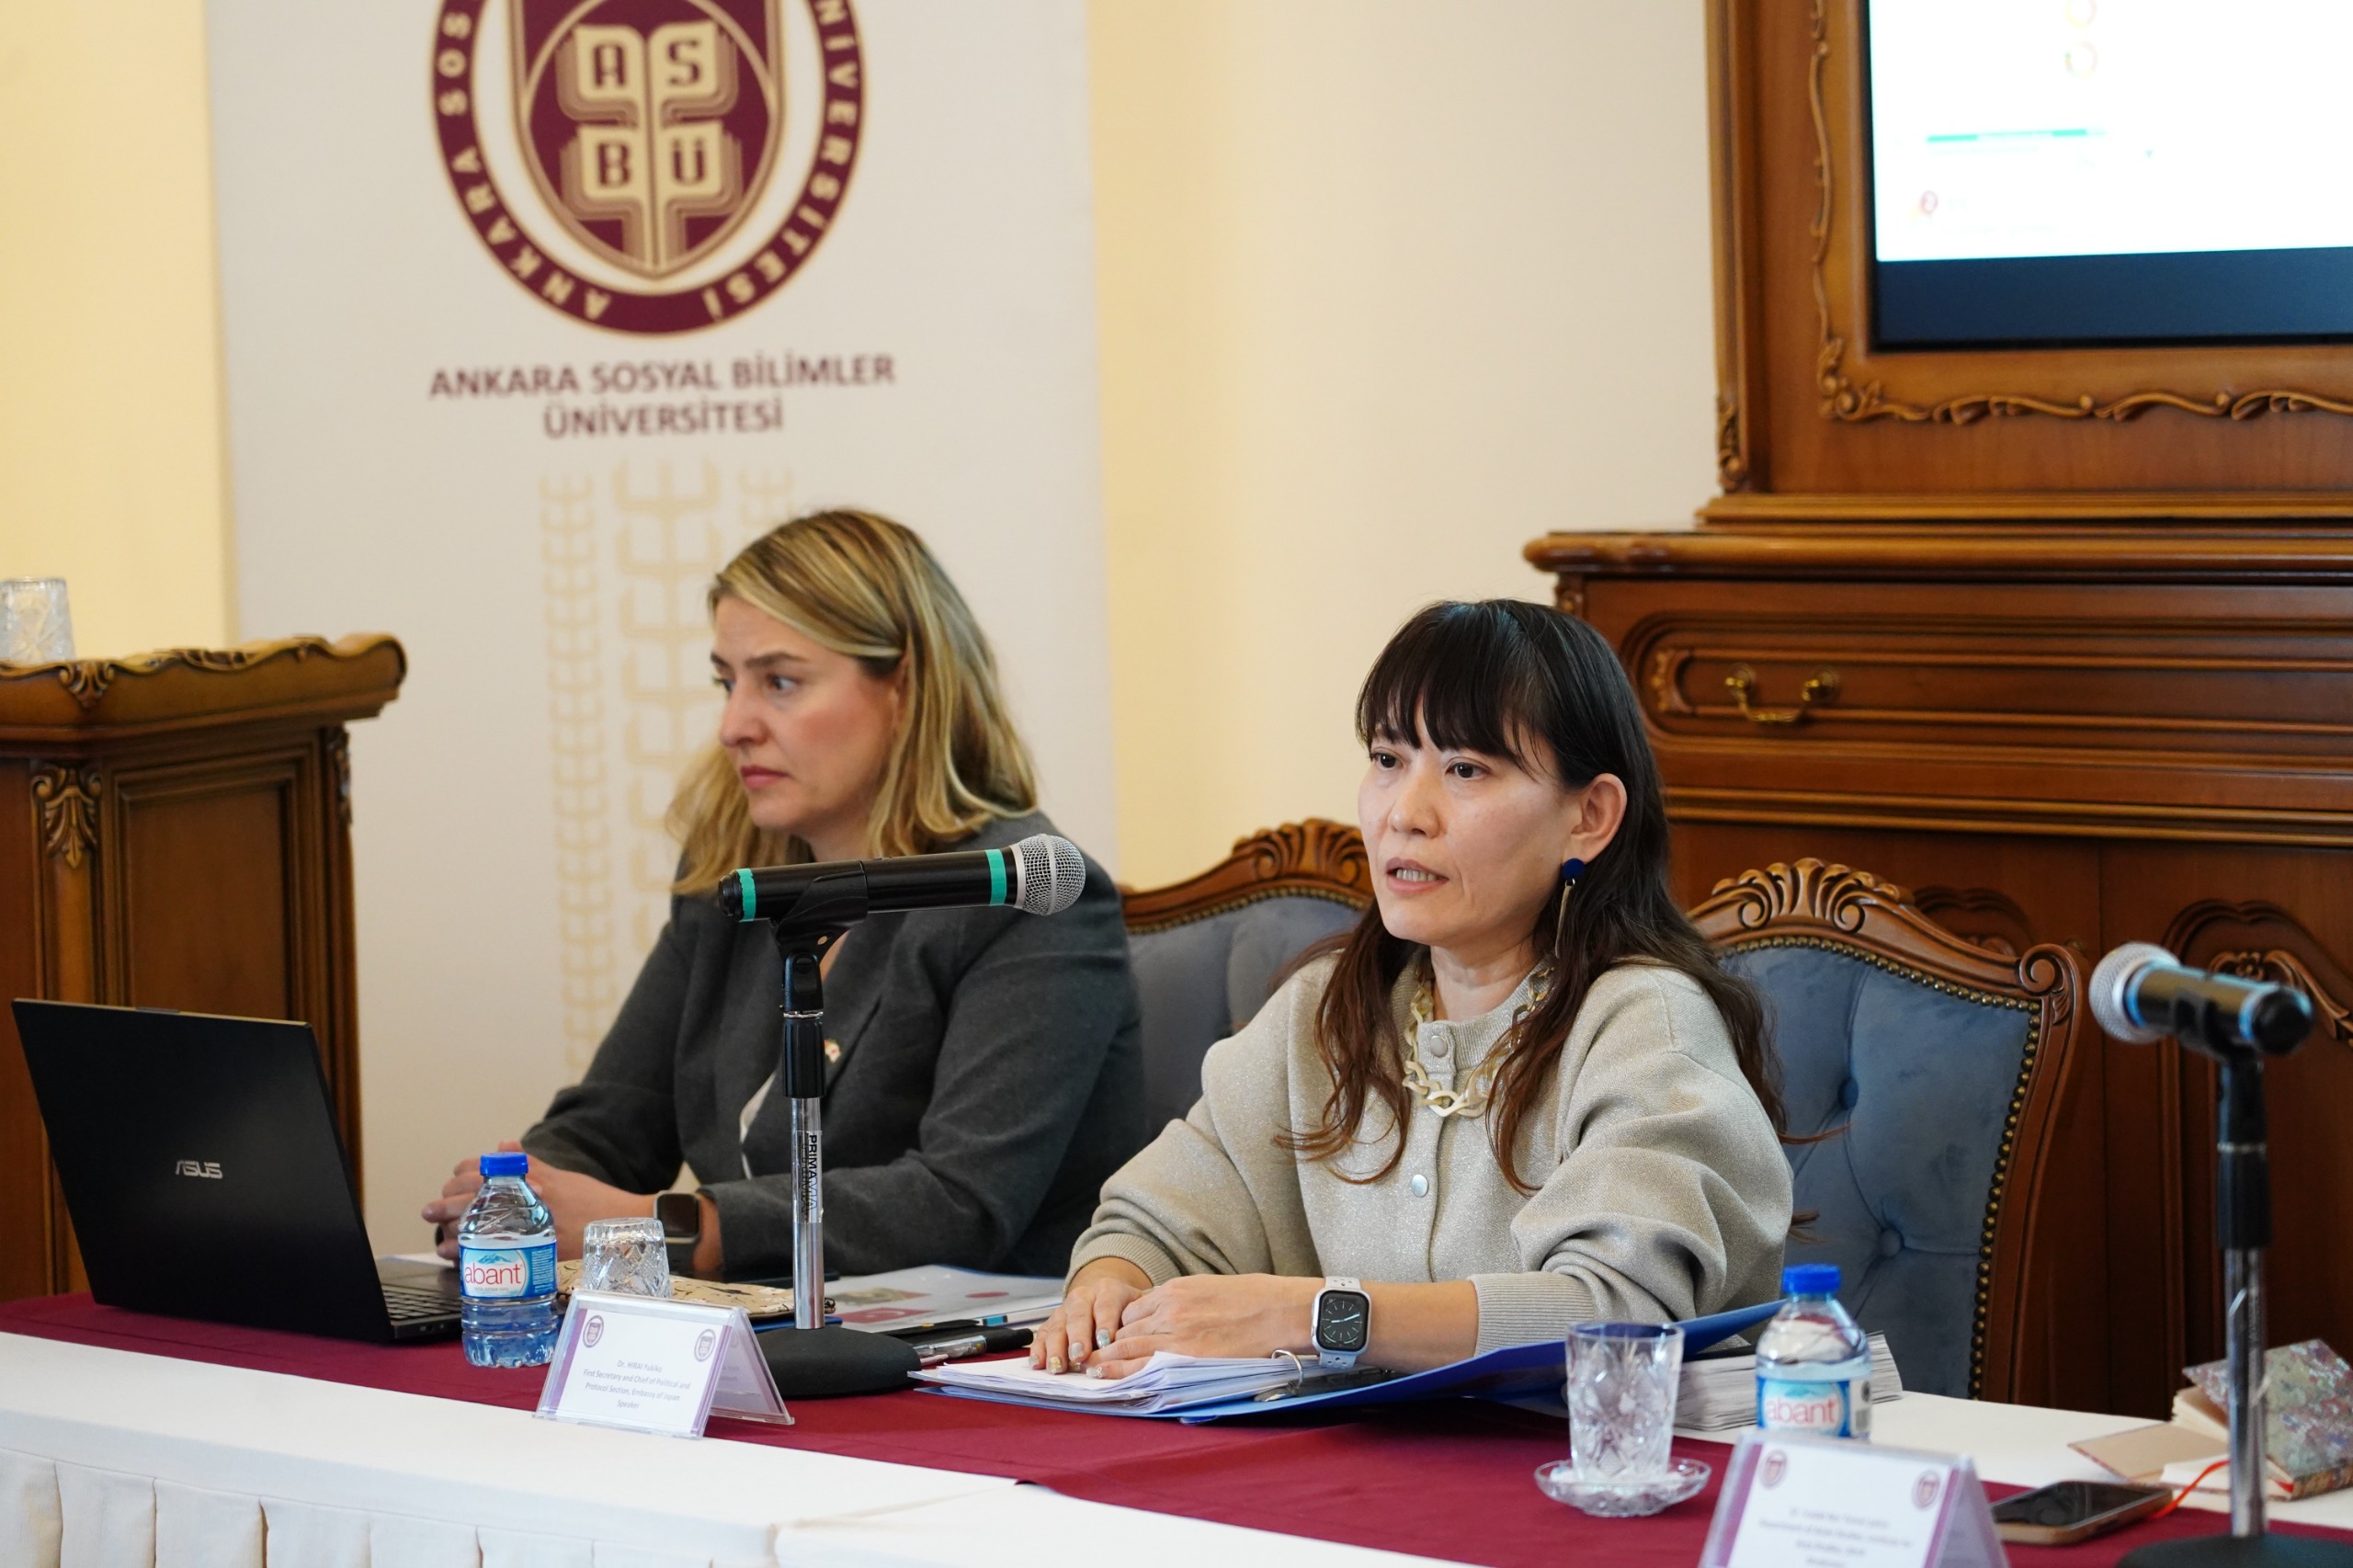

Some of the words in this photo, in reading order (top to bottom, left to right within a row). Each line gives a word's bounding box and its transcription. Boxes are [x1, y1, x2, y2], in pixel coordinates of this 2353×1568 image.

[451, 145, 611, 320] ANKARA
[430, 366, 580, 399] ANKARA
[591, 359, 722, 393] SOSYAL
[732, 349, 895, 390] BİLİMLER
[543, 395, 783, 439] ÜNİVERSİTESİ
[176, 1160, 223, 1179] ASUS
[464, 1262, 521, 1285] abant
[584, 1369, 596, 1378] First
[596, 1370, 622, 1381] Secretary
[585, 1381, 609, 1392] Protocol
[618, 1399, 640, 1409] Speaker
[1766, 1396, 1836, 1424] abant
